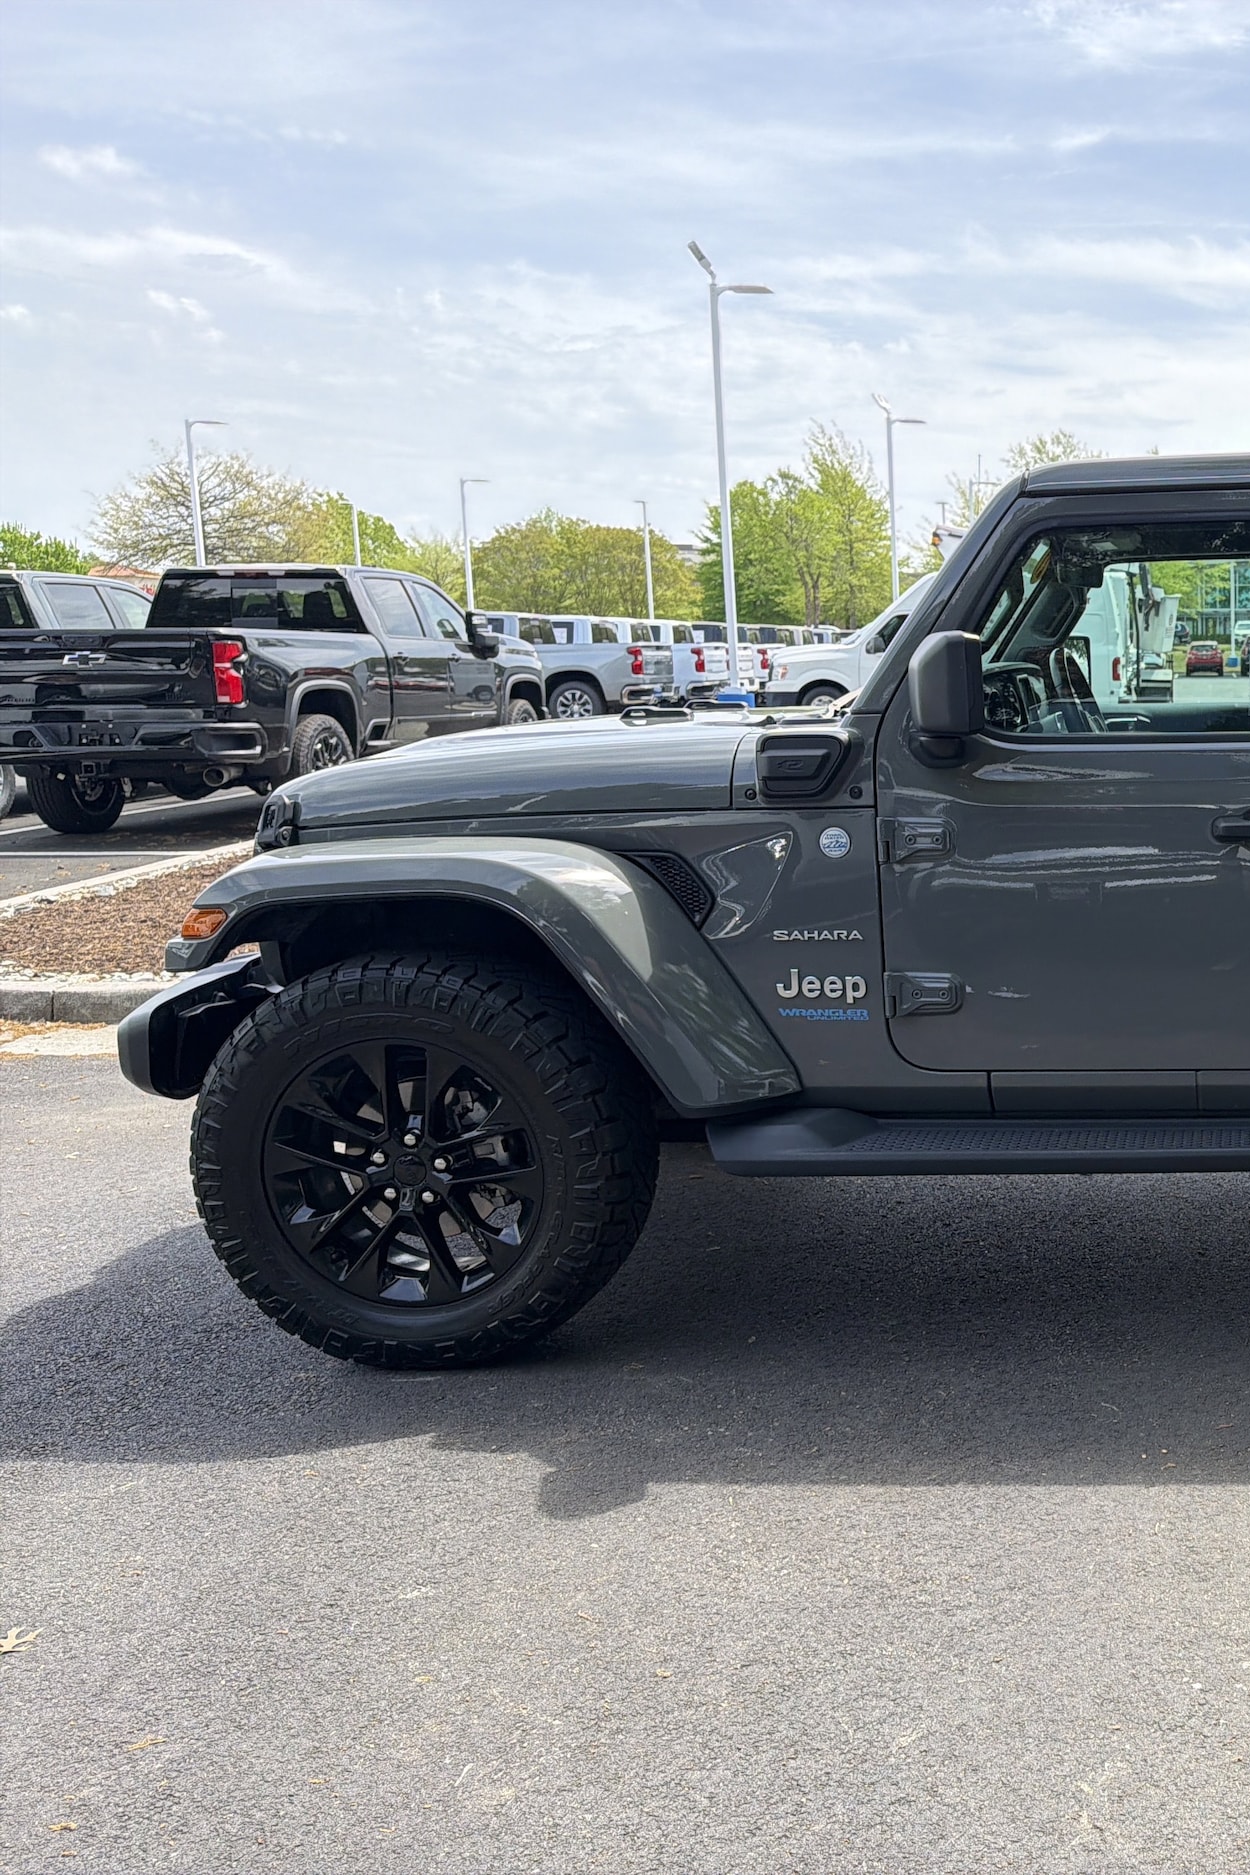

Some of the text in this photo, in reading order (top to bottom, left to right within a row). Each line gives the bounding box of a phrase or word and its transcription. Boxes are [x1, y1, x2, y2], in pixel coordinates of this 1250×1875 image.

[773, 930, 863, 941] SAHARA
[776, 969, 867, 1004] Jeep
[778, 1008, 869, 1017] WRANGLER
